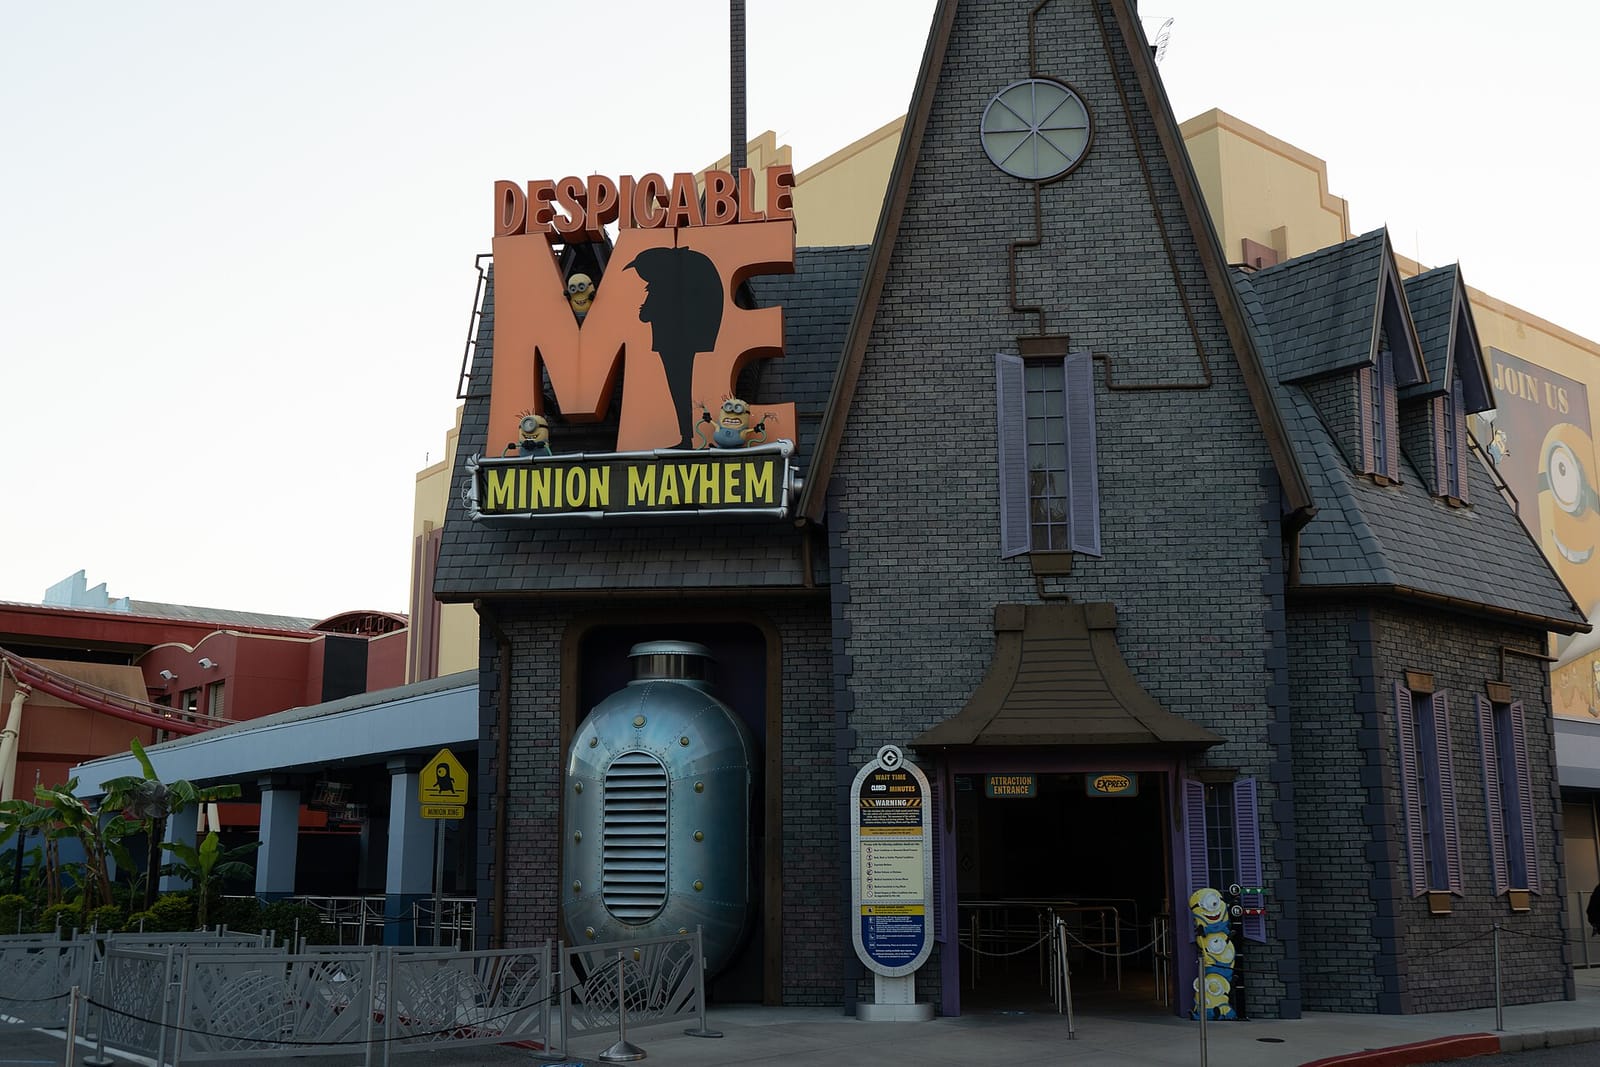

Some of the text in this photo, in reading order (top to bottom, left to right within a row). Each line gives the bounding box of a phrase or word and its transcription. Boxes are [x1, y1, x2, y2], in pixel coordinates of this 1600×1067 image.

[494, 165, 796, 237] DESPICABLE
[486, 220, 798, 457] ME
[1494, 363, 1569, 414] JOIN US
[487, 461, 774, 510] MINION MAYHEM
[990, 776, 1032, 786] ATTRACTION
[993, 785, 1029, 794] ENTRANCE
[1096, 779, 1128, 792] EXPRESS
[875, 799, 907, 807] WARNING
